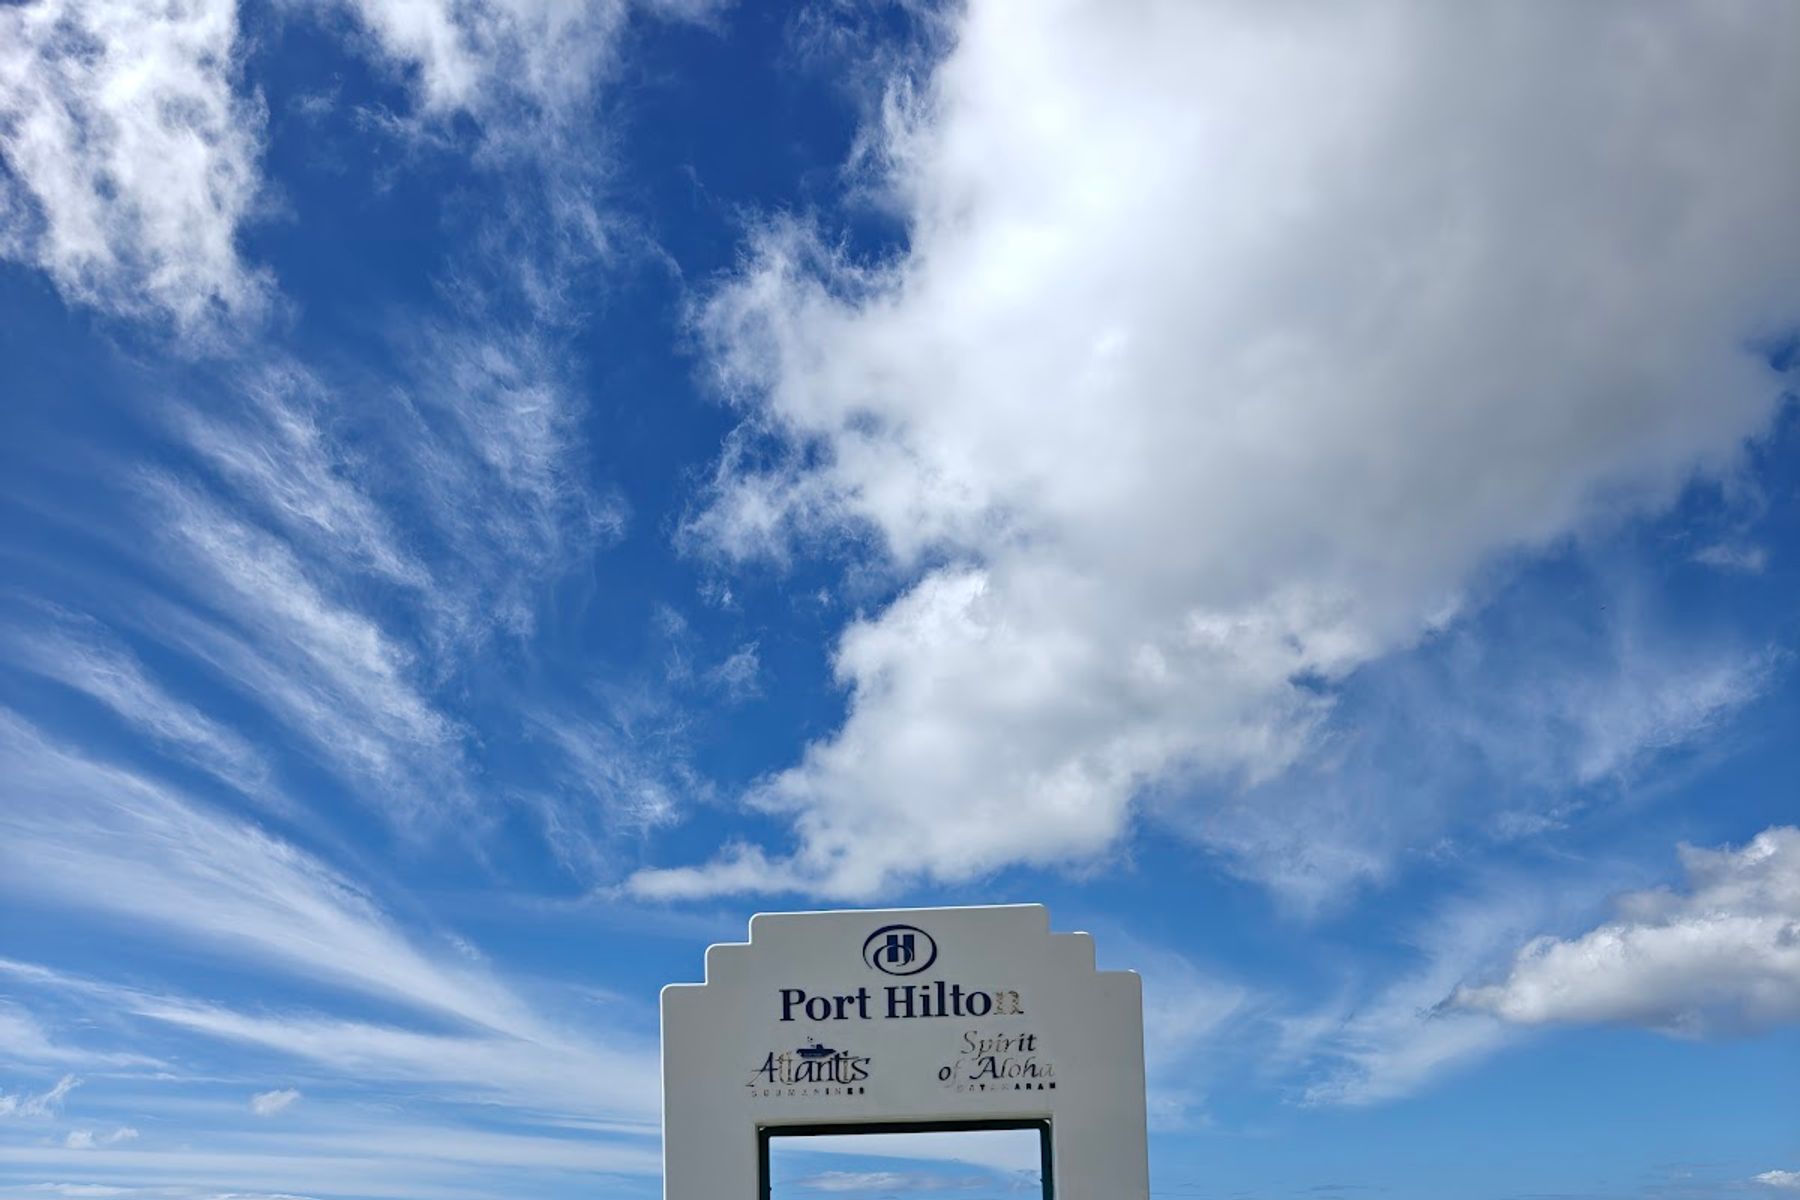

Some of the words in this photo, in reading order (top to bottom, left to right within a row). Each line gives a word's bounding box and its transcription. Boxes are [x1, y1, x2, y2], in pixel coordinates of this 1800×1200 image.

[778, 986, 872, 1022] Port
[883, 980, 1025, 1019] Hilton
[960, 1030, 1037, 1060] Spirit
[745, 1051, 871, 1086] Atlantis
[968, 1055, 1055, 1080] Aloha
